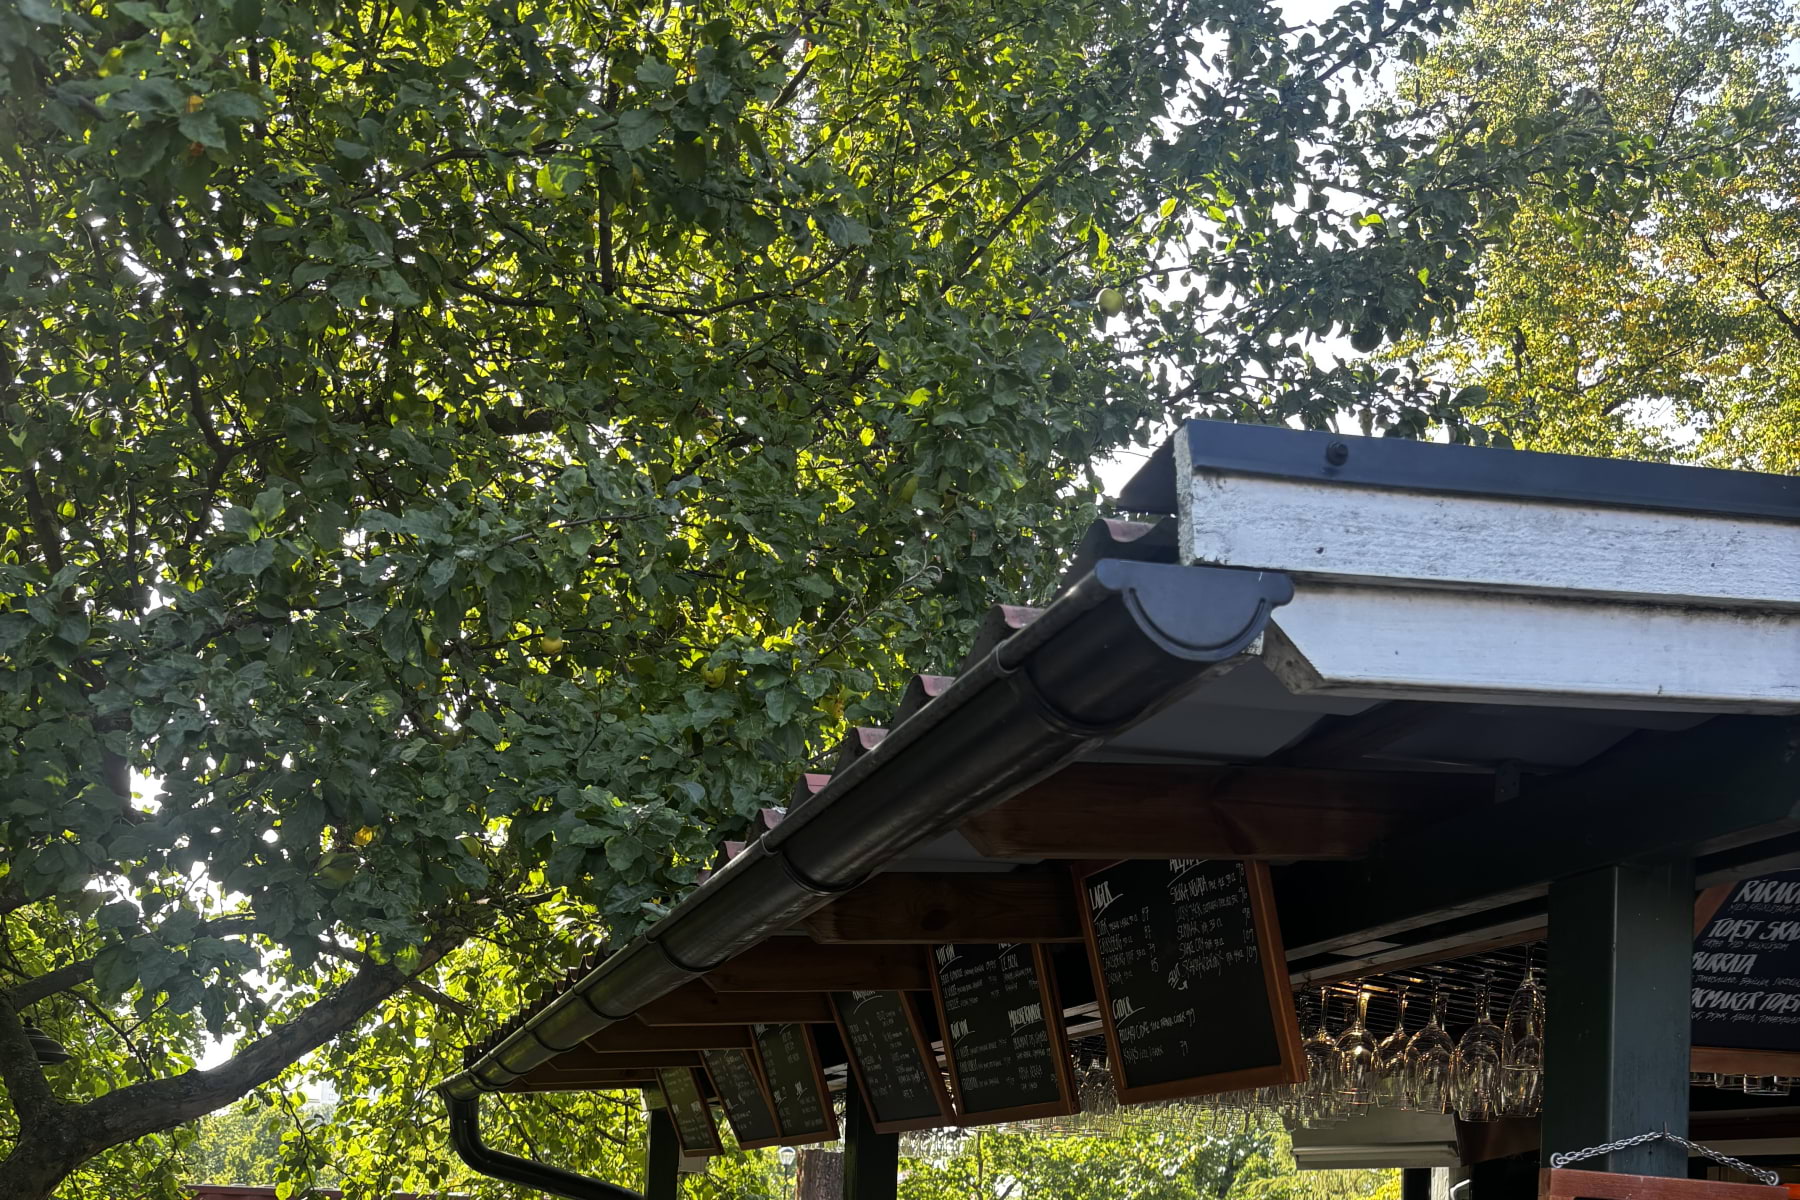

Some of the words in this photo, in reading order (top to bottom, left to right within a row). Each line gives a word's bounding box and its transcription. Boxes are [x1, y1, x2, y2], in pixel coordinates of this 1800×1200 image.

[1708, 918, 1765, 942] TOAST
[1759, 920, 1800, 942] SKA
[1692, 951, 1758, 975] BURRATA
